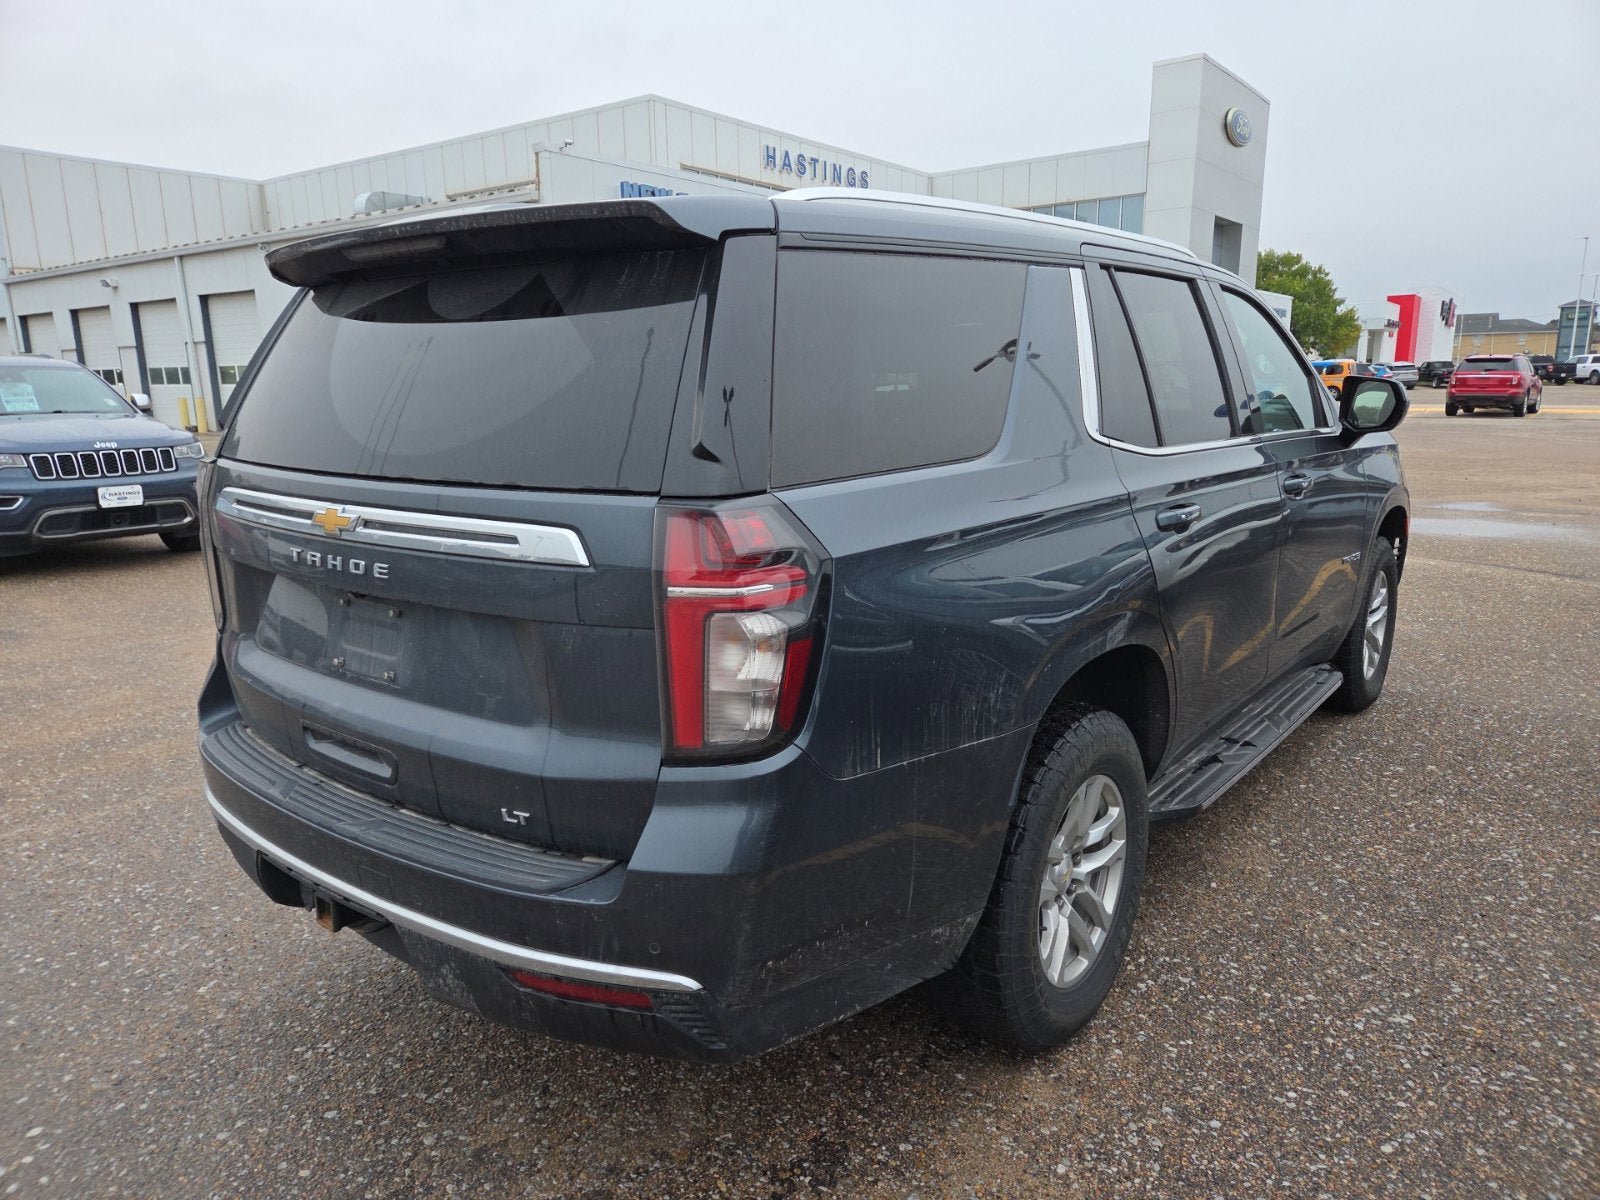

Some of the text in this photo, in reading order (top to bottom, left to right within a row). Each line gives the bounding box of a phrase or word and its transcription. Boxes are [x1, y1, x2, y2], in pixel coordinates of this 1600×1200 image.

[763, 144, 870, 189] HASTINGS
[93, 441, 118, 449] Jeep
[289, 547, 391, 580] TAHOE
[500, 807, 531, 826] LT
